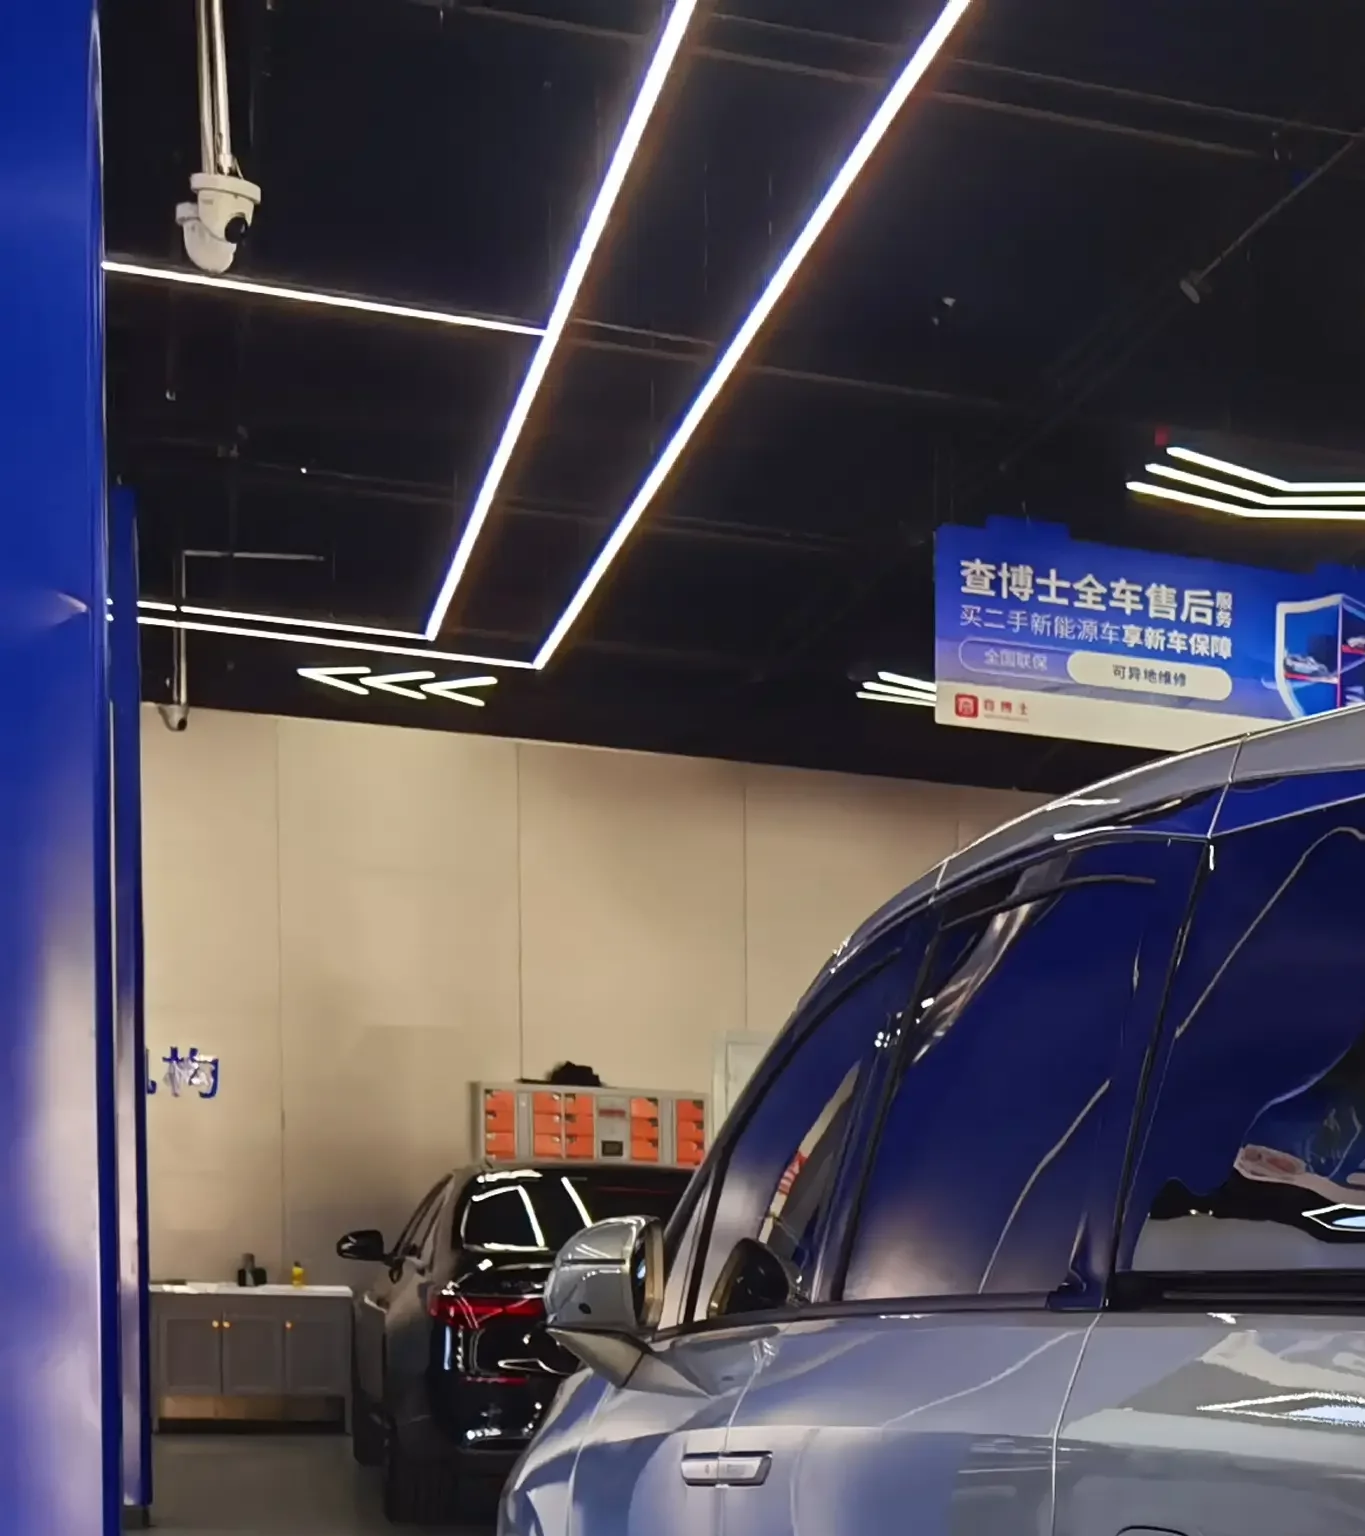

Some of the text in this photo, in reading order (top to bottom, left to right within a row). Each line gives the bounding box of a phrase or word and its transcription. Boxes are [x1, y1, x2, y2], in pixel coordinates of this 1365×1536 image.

[960, 559, 1214, 626] 查博士全车售后
[959, 605, 1232, 660] 买二手新能源车享新车保障
[984, 648, 1048, 672] 全国联保
[1112, 664, 1187, 688] 可异地维修
